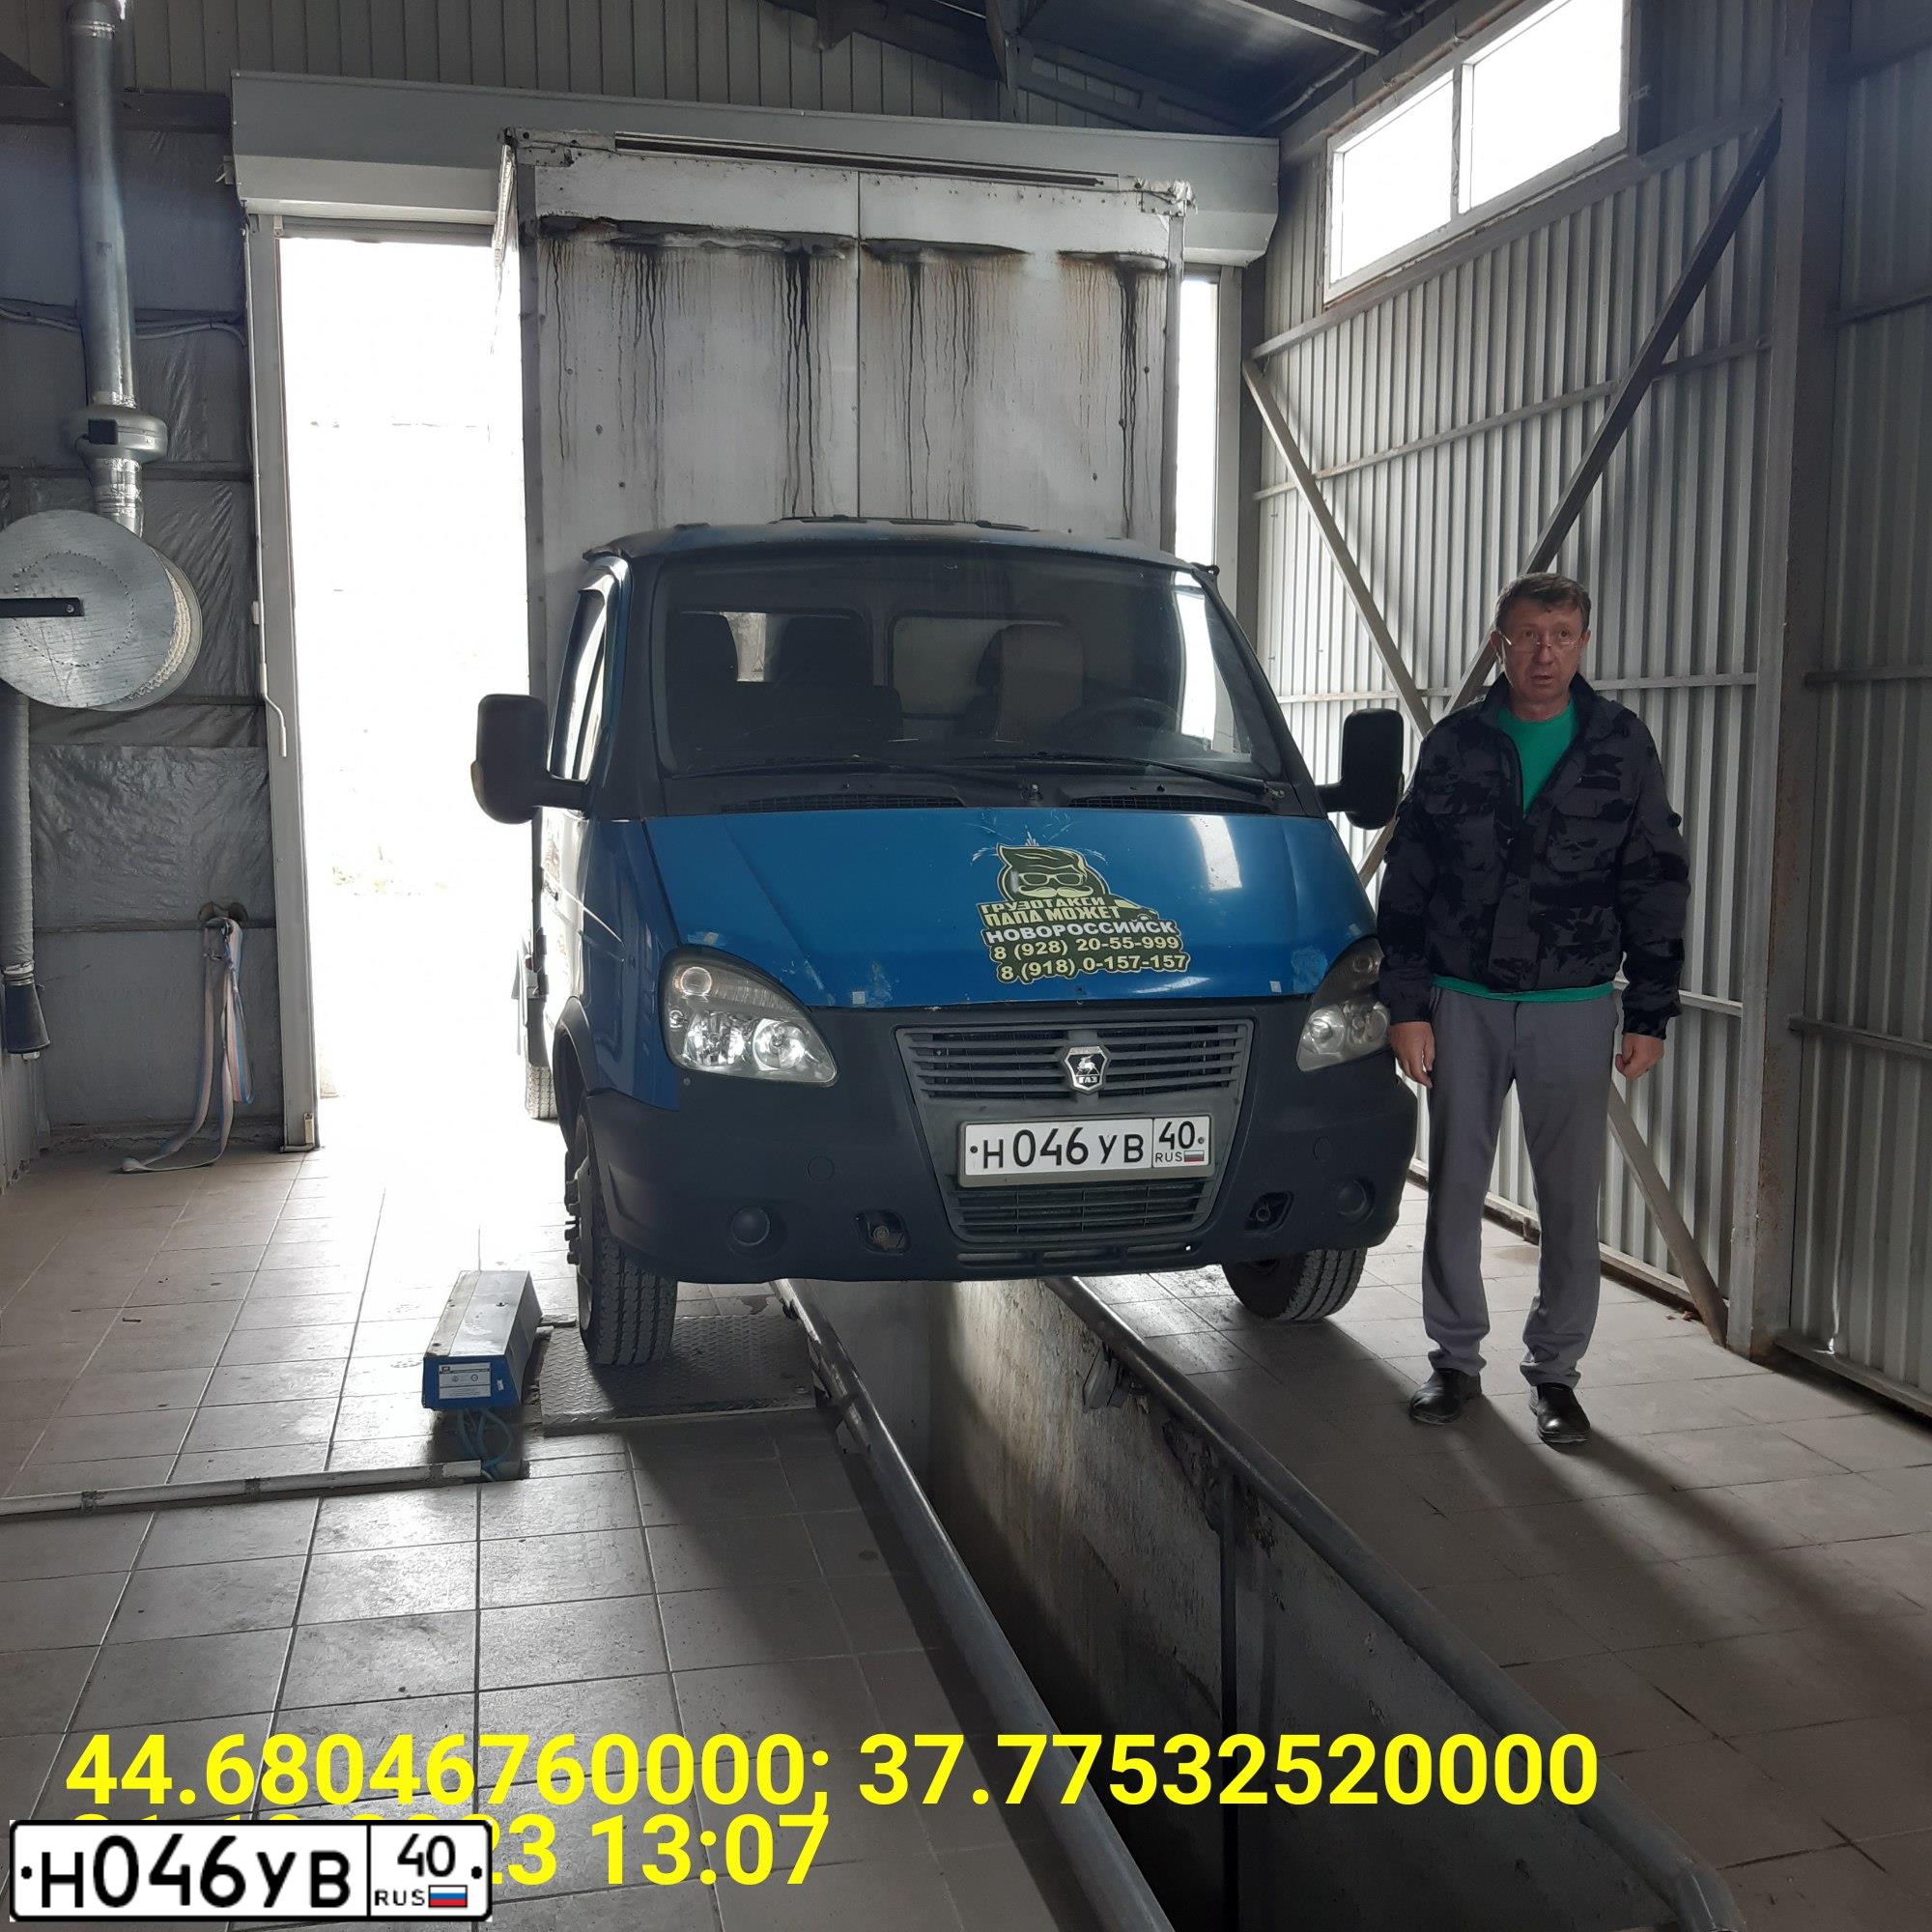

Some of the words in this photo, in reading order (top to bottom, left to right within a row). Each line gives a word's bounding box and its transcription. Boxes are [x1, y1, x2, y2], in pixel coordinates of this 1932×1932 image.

[980, 897, 1105, 914] ГРУЗОТАКСИ
[984, 910, 1038, 927] ПАПА
[1046, 904, 1121, 923] МОЖЕТ
[986, 919, 1177, 945] НОВОРОССИЙСК
[993, 946, 1007, 961] 8
[1013, 939, 1068, 959] (928)
[1075, 936, 1179, 952] 20-55-999
[1001, 965, 1014, 980] 8
[1021, 958, 1075, 981] (918)
[1082, 954, 1186, 972] 0-157-157
[1158, 1121, 1196, 1151] 40
[1154, 1151, 1183, 1164] RUS
